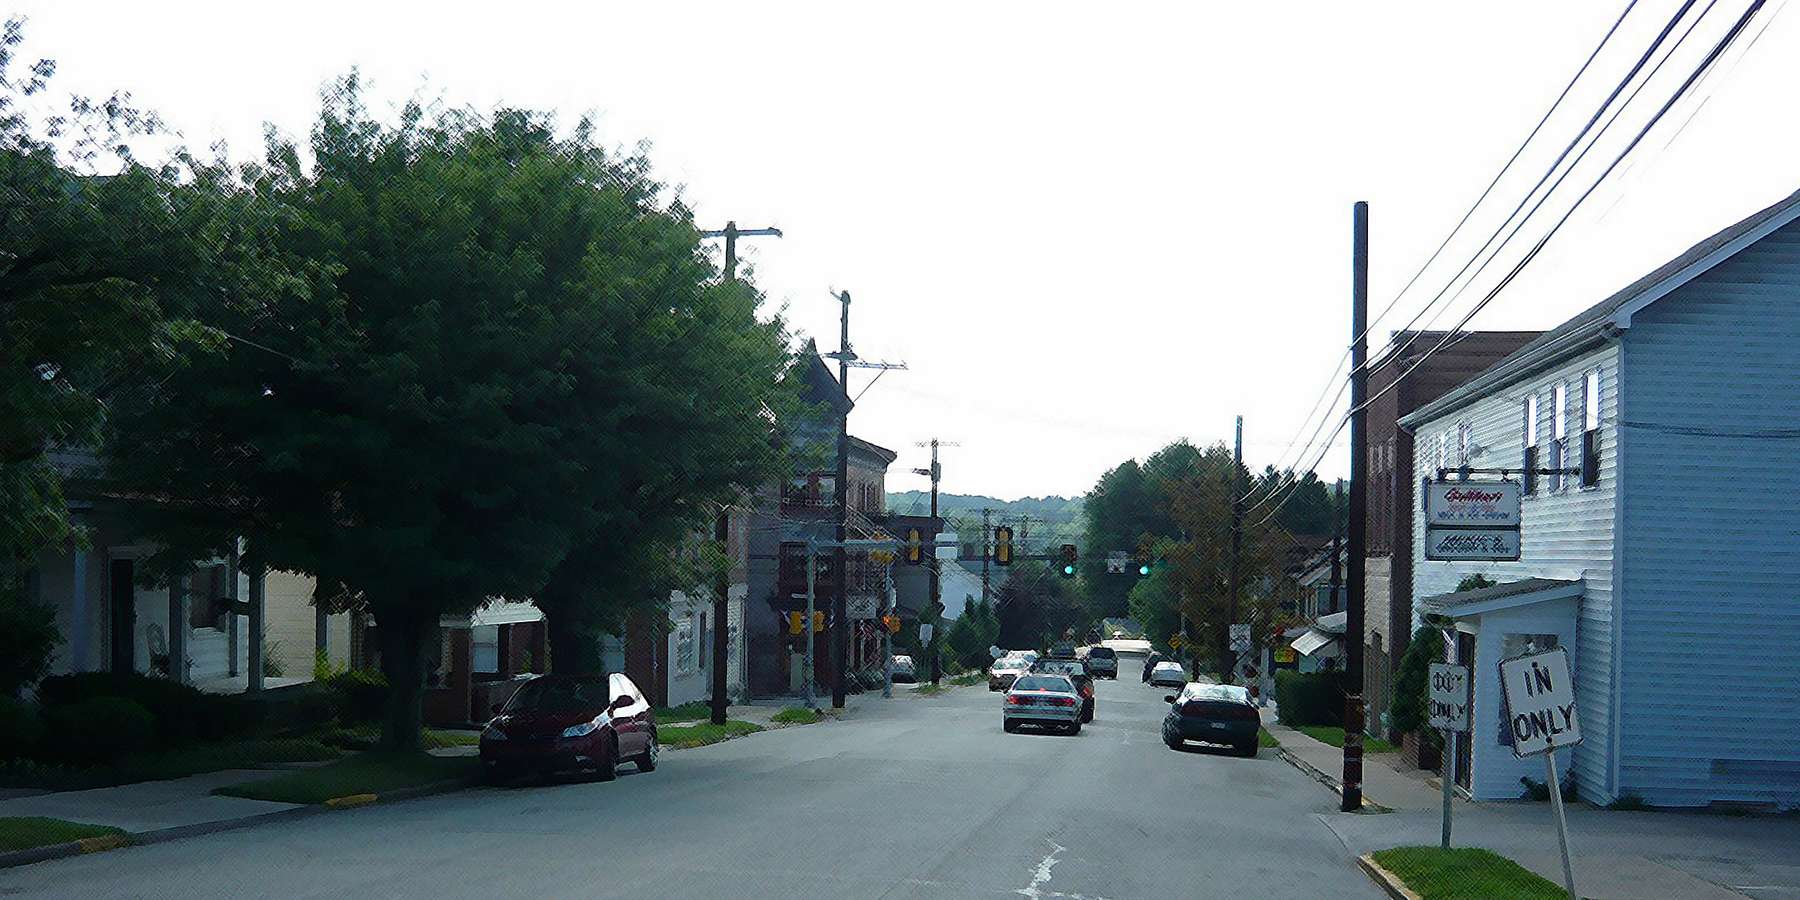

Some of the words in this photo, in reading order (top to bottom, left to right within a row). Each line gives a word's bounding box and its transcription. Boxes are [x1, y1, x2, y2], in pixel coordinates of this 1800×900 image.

[1523, 665, 1553, 698] IN
[1430, 699, 1466, 722] ONLY
[1513, 702, 1576, 742] ONLY
